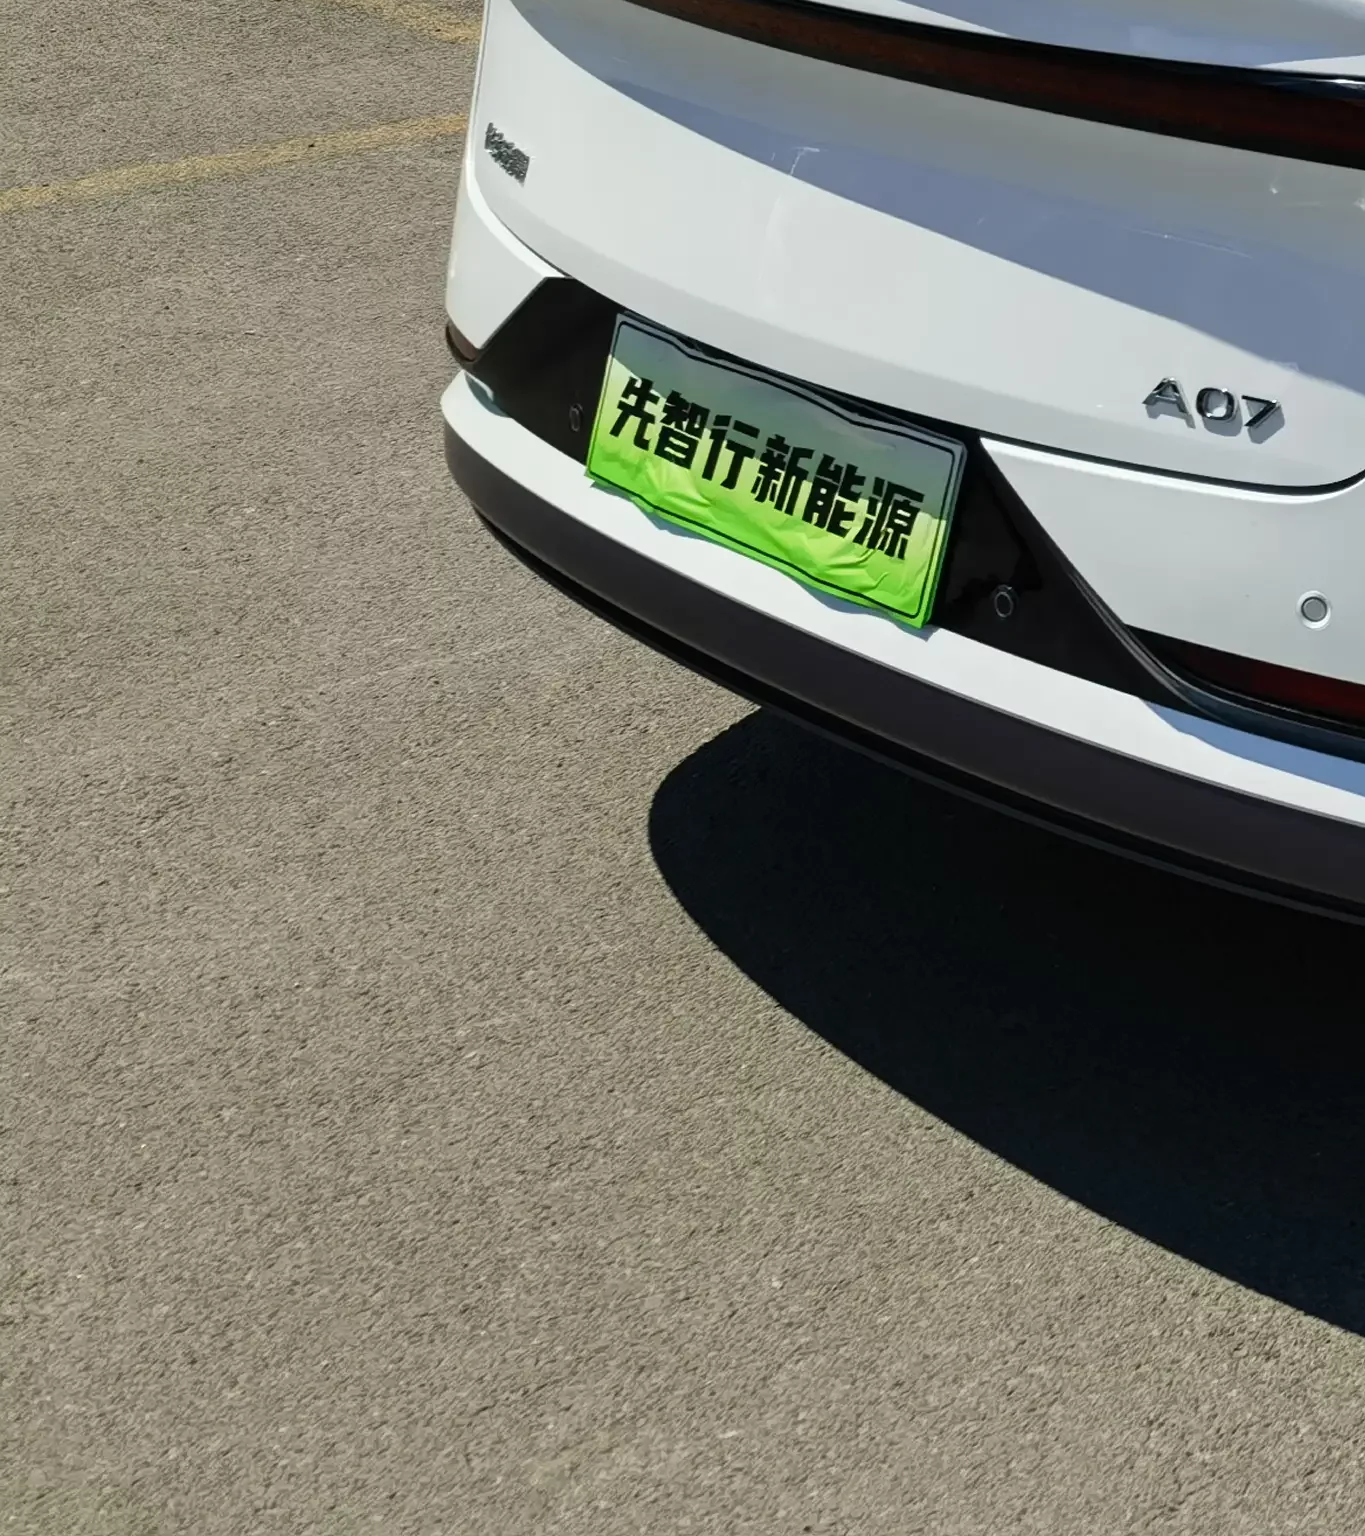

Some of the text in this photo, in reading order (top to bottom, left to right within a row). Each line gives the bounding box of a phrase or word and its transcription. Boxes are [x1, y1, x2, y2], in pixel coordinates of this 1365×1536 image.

[608, 375, 927, 562] 先智行新能源
